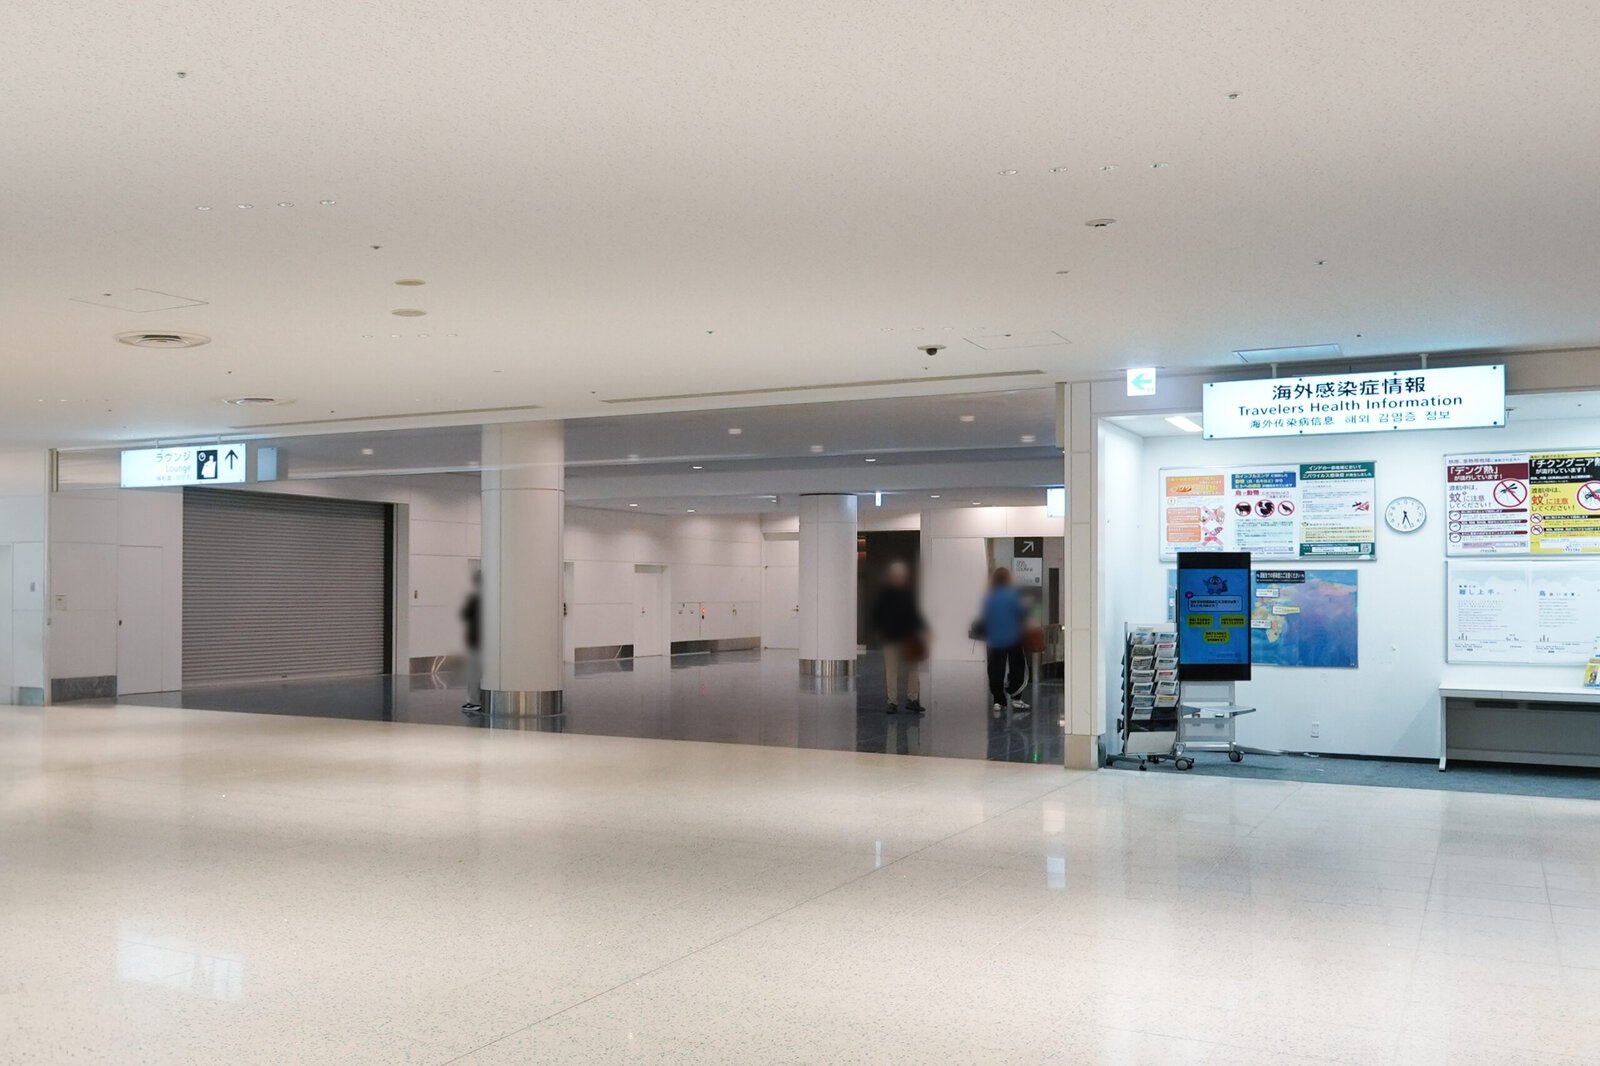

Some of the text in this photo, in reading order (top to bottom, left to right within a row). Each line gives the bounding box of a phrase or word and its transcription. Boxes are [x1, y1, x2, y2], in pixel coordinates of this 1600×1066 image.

[1272, 377, 1426, 400] 海外感染症情報
[1238, 395, 1462, 416] Travelers Health Information
[1425, 409, 1451, 421] 정보
[1250, 416, 1334, 429] 海外传染病信息
[156, 451, 191, 463] ラウンジ
[165, 465, 192, 474] Lounge
[1450, 465, 1499, 475] 「デング熱」
